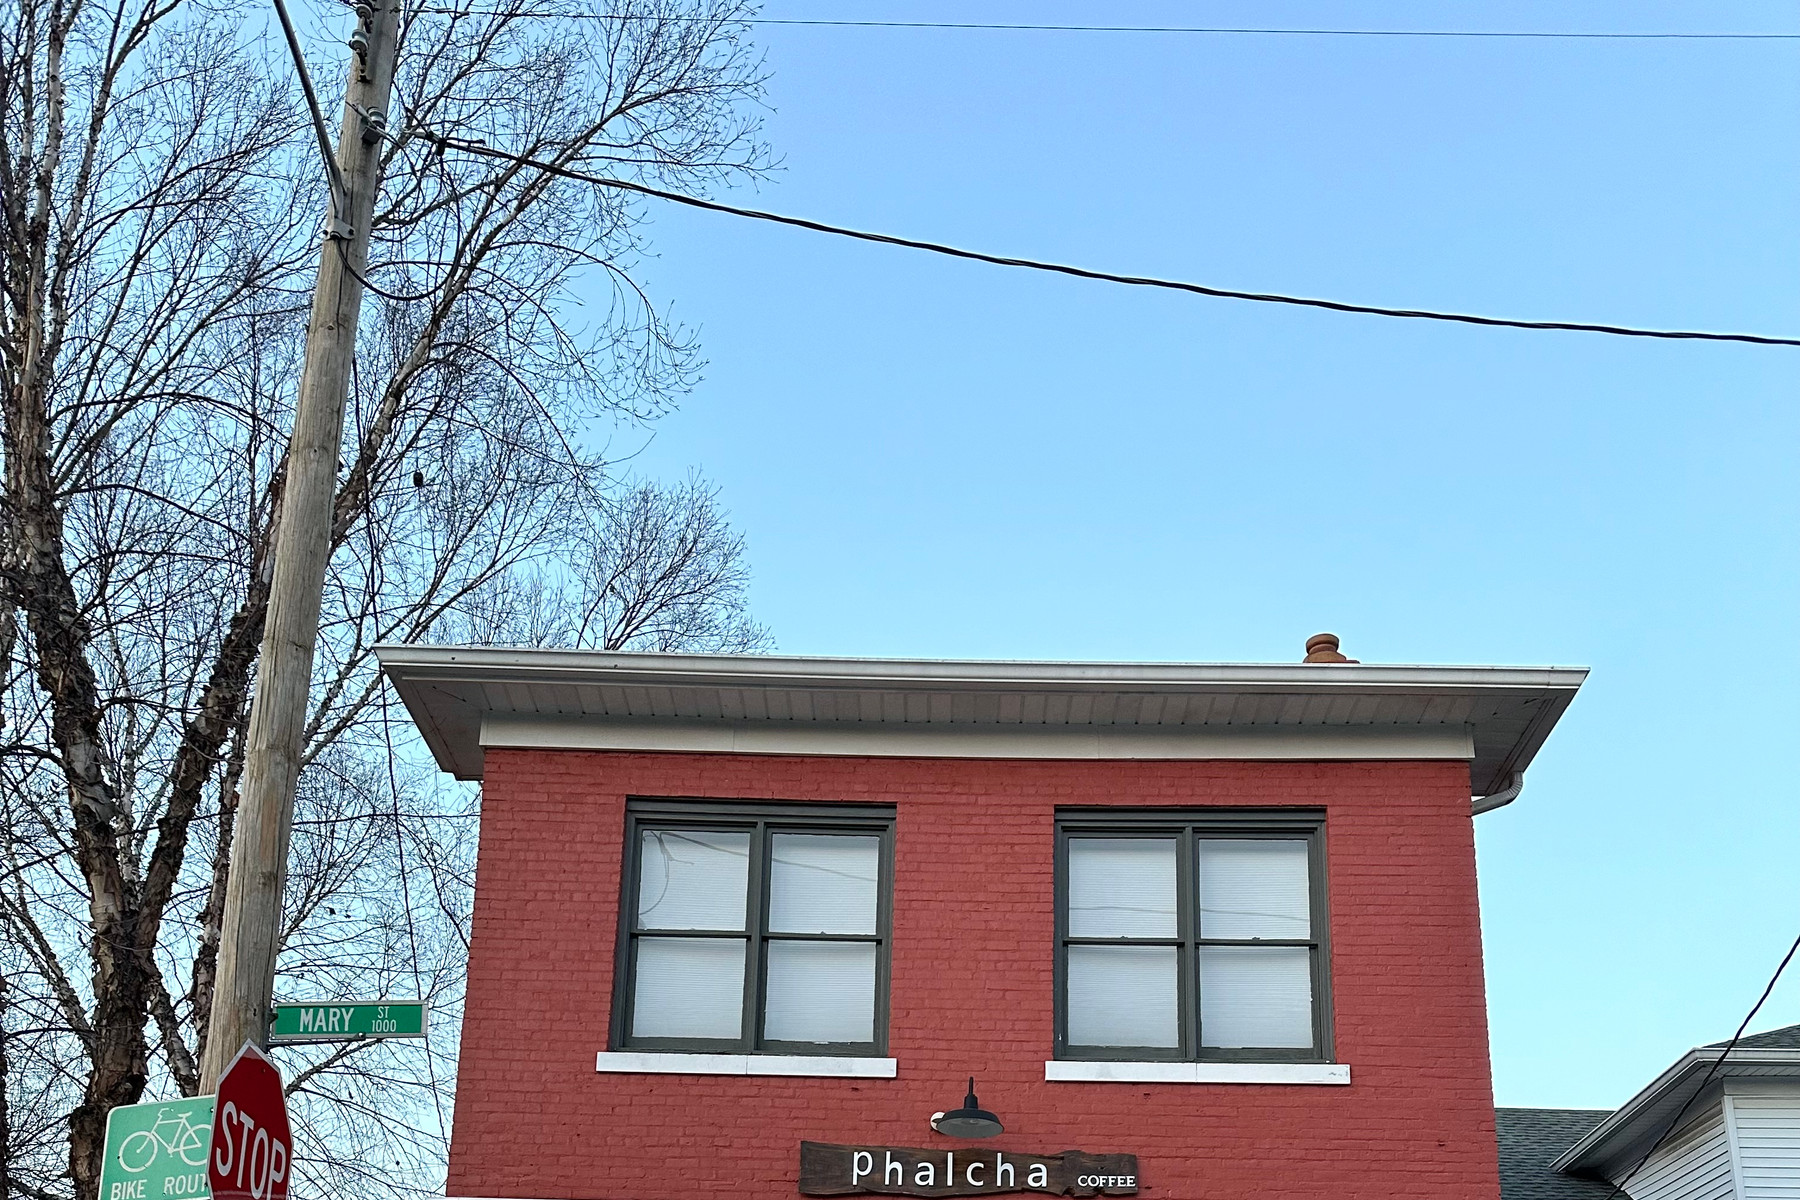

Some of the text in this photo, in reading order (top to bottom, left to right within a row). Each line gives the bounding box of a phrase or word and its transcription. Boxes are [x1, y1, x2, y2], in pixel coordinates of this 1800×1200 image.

[299, 1005, 390, 1033] MARY ST
[371, 1019, 397, 1033] 1000
[851, 1150, 1136, 1188] phalcha COFFEE
[163, 1173, 207, 1196] ROUT
